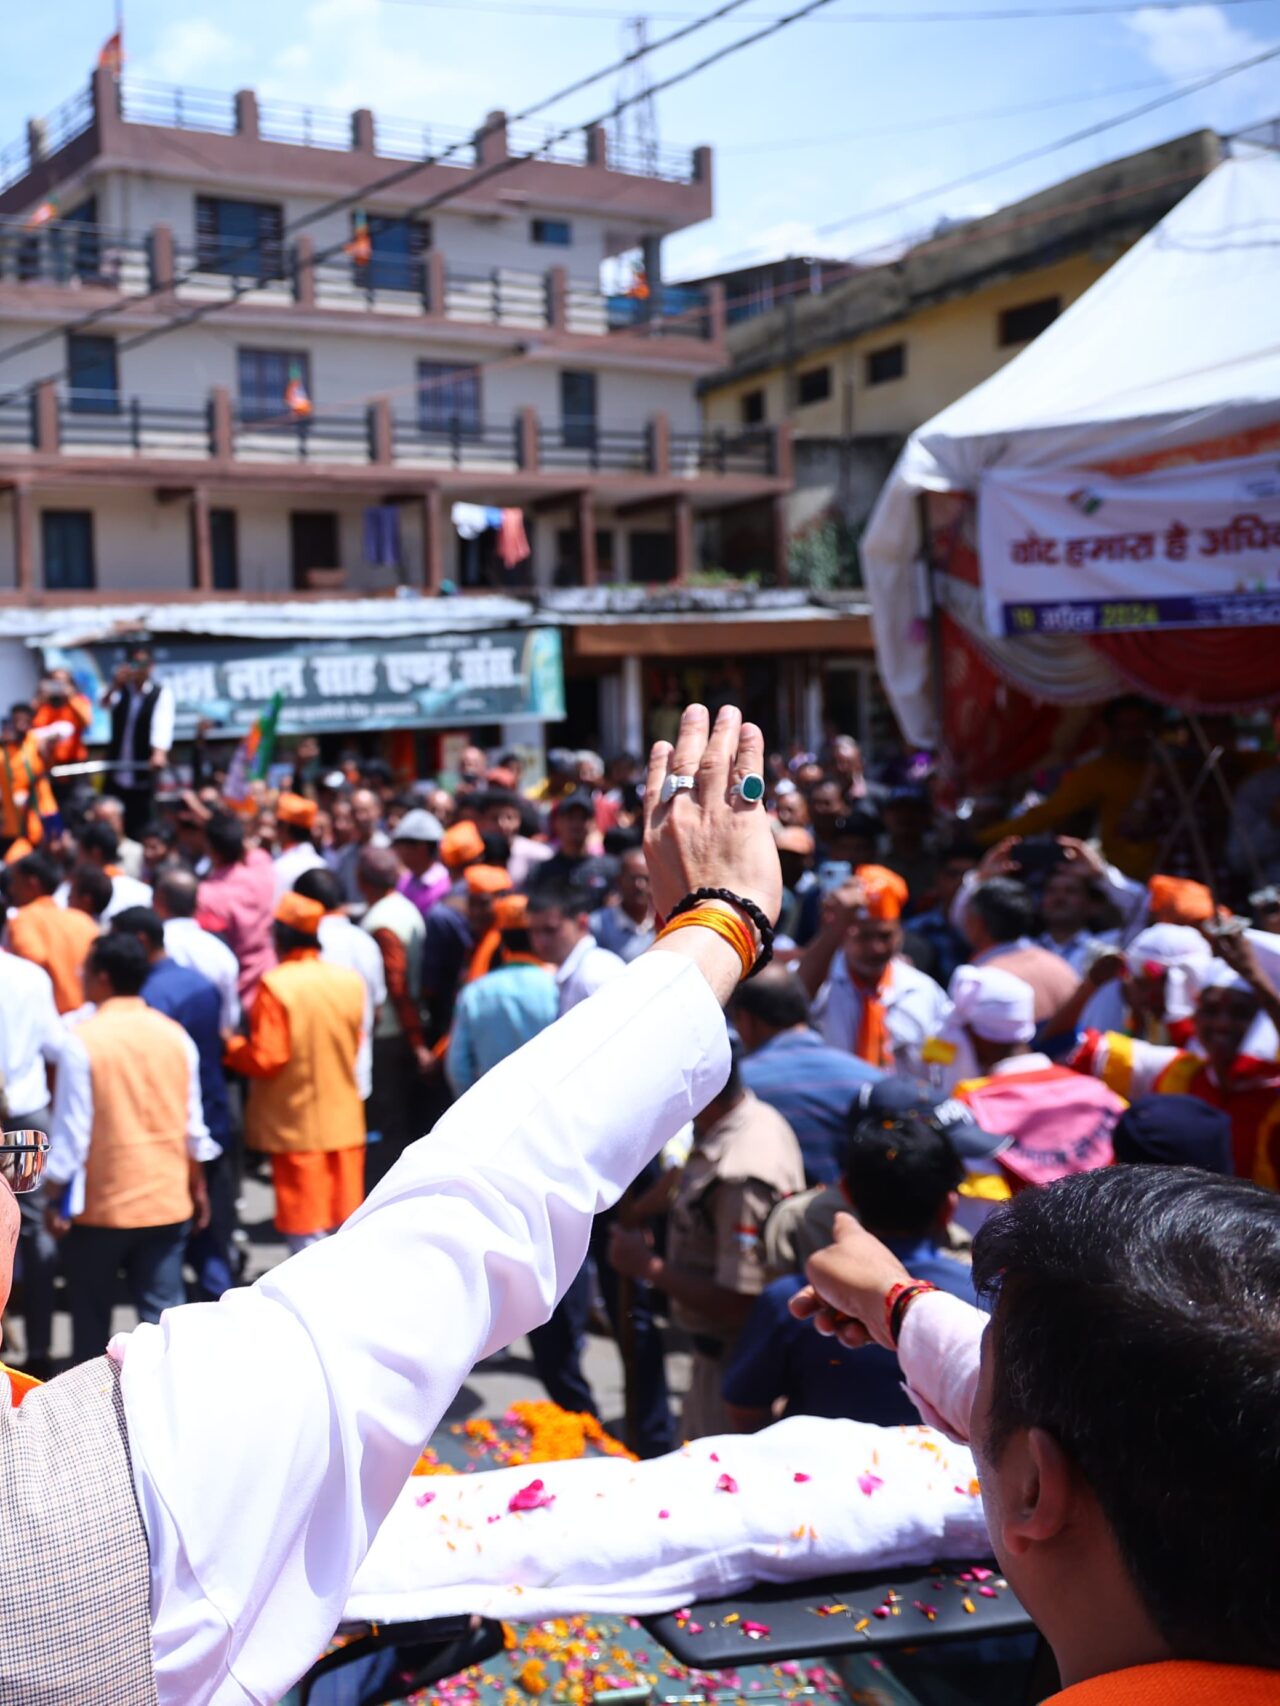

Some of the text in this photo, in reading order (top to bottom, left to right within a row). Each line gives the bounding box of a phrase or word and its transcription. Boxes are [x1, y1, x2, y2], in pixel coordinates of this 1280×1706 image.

[1066, 532, 1155, 568] हमारा
[1165, 518, 1189, 562] है
[1101, 603, 1160, 627] 2024
[223, 656, 307, 700] लाल
